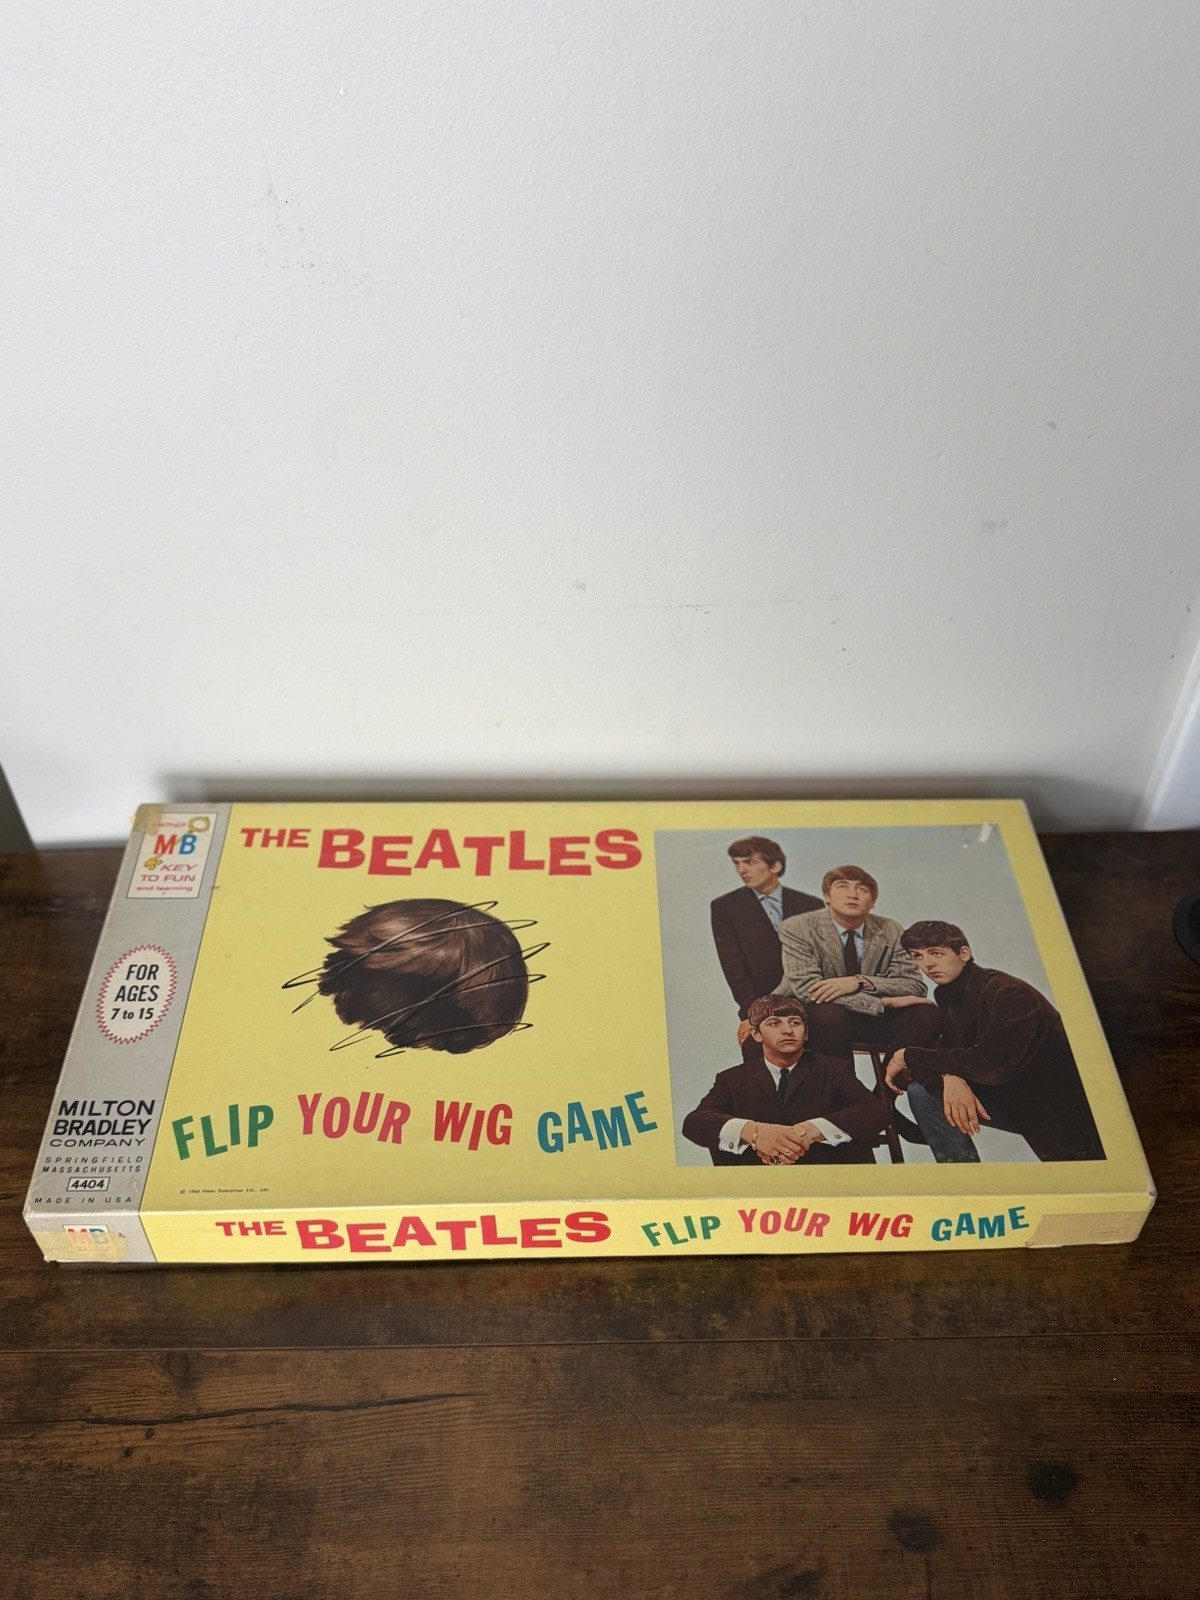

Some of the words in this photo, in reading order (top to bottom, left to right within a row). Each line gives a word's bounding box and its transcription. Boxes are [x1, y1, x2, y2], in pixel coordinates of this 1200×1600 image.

[240, 827, 311, 848] THE
[317, 828, 642, 876] BEATLES
[160, 863, 198, 871] KEY
[140, 874, 160, 882] TO
[164, 874, 196, 882] FUN
[126, 964, 159, 981] FOR
[114, 985, 160, 1002] AGES
[111, 1008, 121, 1020] 7
[122, 1010, 135, 1020] to
[138, 1007, 154, 1020] 15
[58, 1100, 156, 1117] MILTON
[53, 1119, 152, 1136] BRADLEY
[171, 1103, 274, 1161] FLIP
[297, 1091, 411, 1145] YOUR
[433, 1100, 513, 1151] WIG
[536, 1091, 658, 1154] GAME
[49, 1138, 146, 1148] COMPANY
[45, 1156, 143, 1164] SPRINGFIELD
[42, 1165, 141, 1173] MASSACHUSETTS
[71, 1180, 105, 1189] 4404
[105, 1196, 132, 1204] USA
[215, 1220, 287, 1236] THE
[296, 1211, 612, 1252] BEATLES
[641, 1215, 721, 1247] FLIP
[737, 1207, 831, 1237] YOUR
[847, 1212, 914, 1241] WIG
[930, 1205, 1030, 1242] GAME
